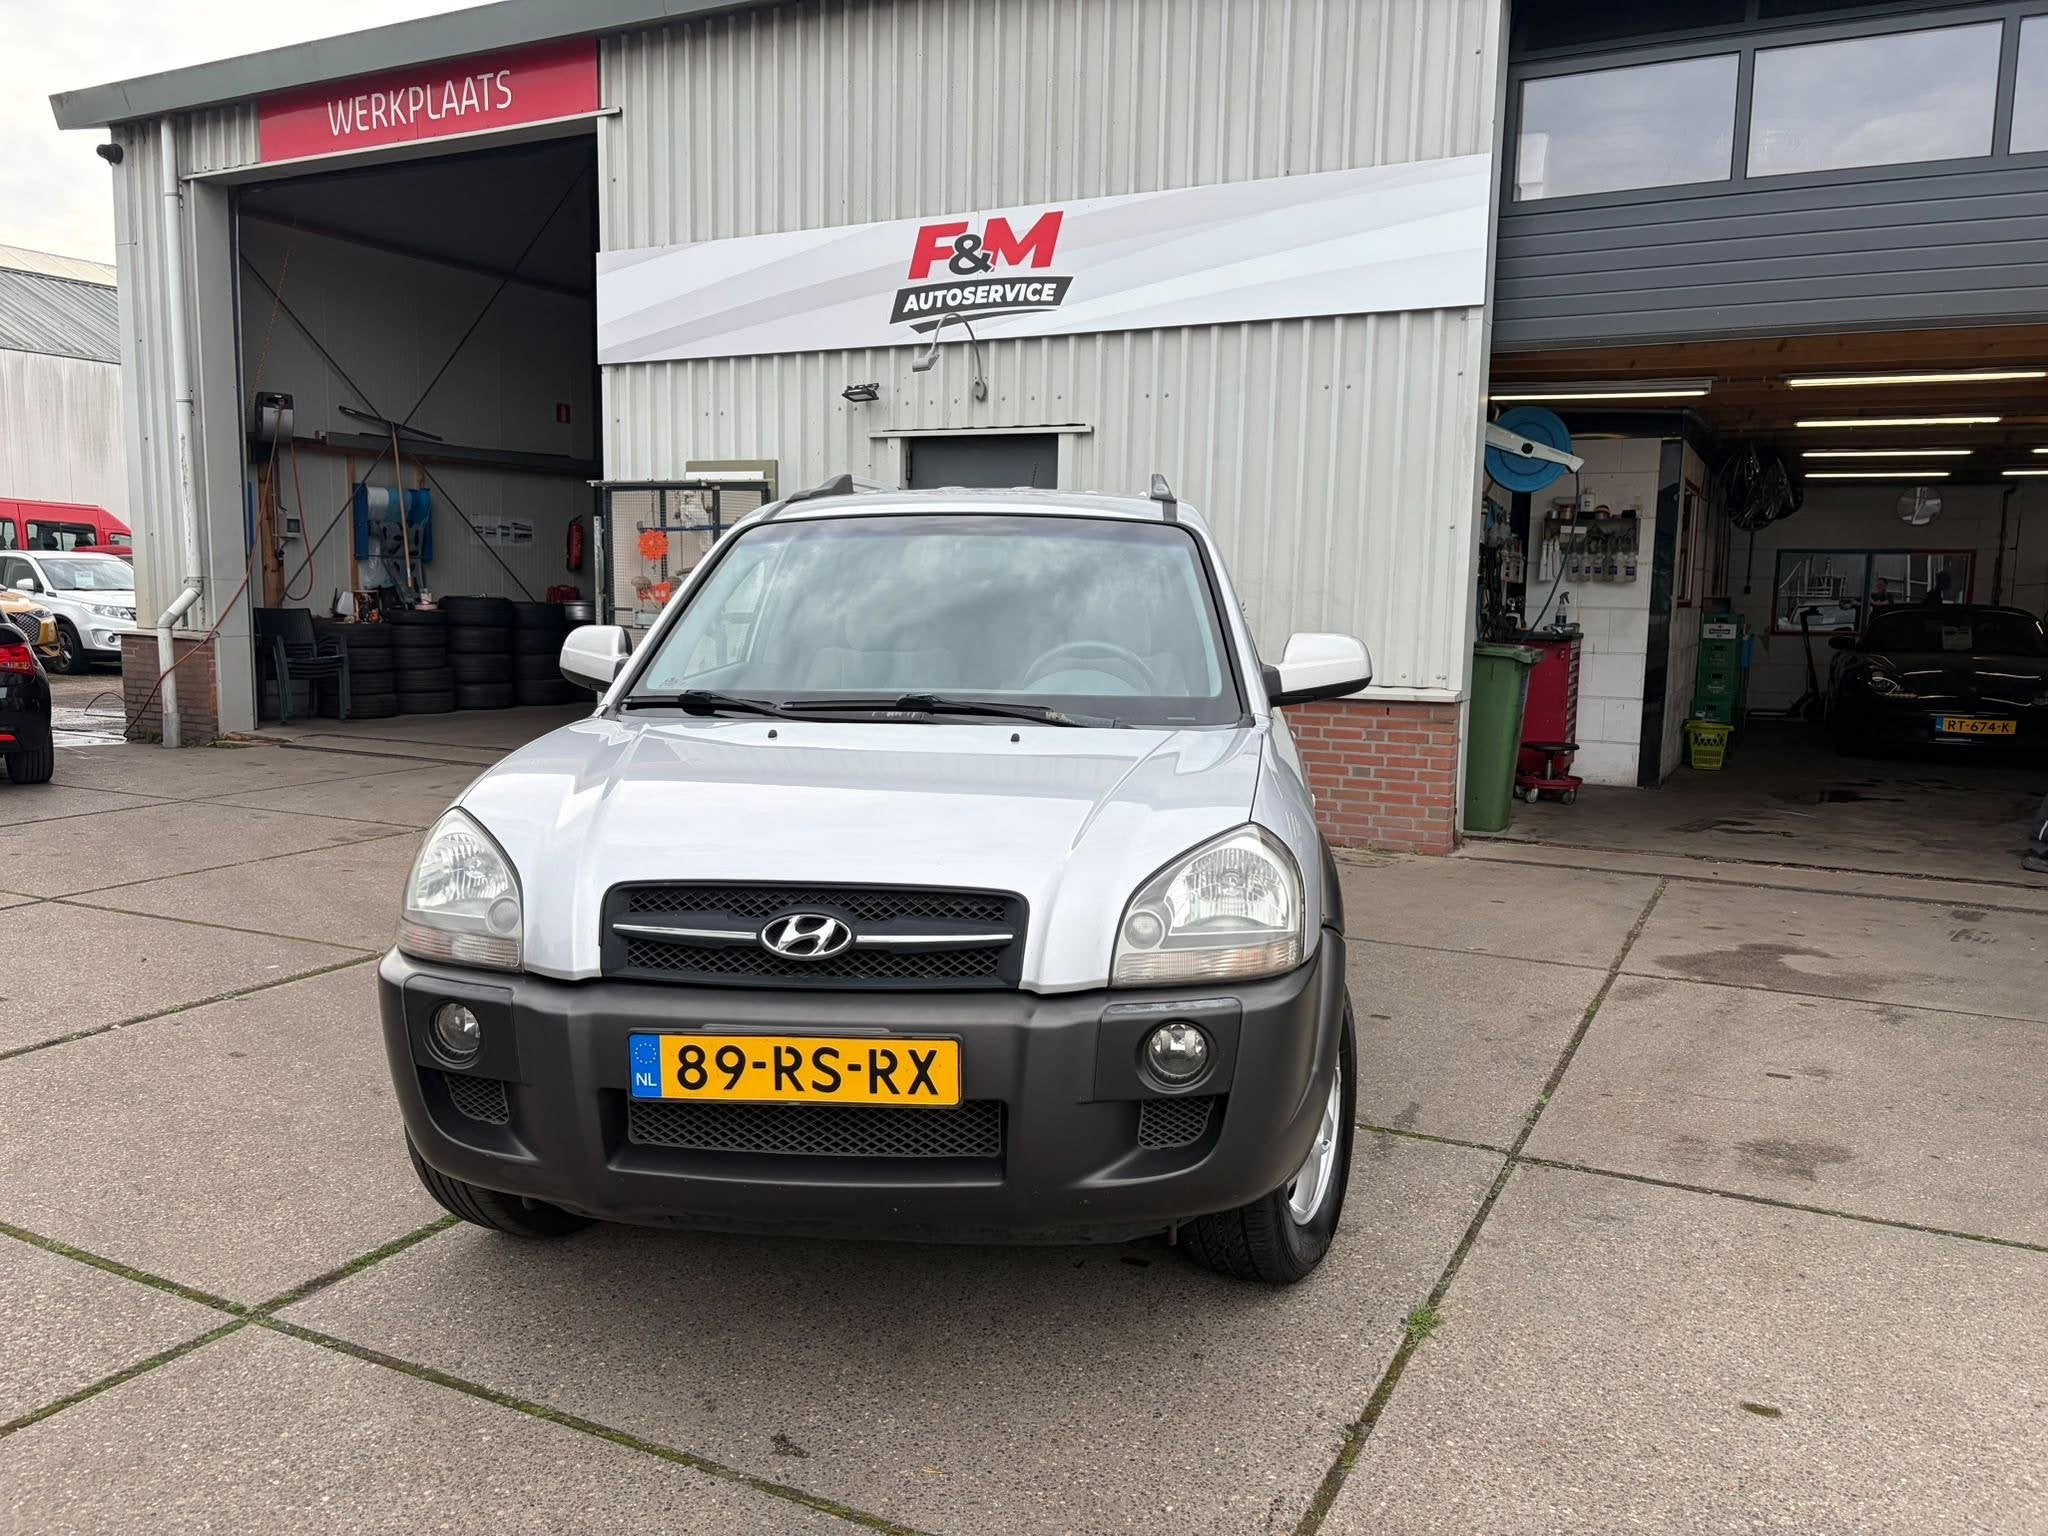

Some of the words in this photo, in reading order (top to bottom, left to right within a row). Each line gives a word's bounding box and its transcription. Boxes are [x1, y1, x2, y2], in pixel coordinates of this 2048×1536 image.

[327, 69, 512, 136] WERKPLAATS
[908, 211, 1064, 280] F&M
[902, 283, 1057, 313] AUTOSERVICE
[1947, 720, 2010, 733] RT-674-K
[636, 1073, 658, 1088] NL
[676, 1044, 939, 1096] 89-RS-RX
